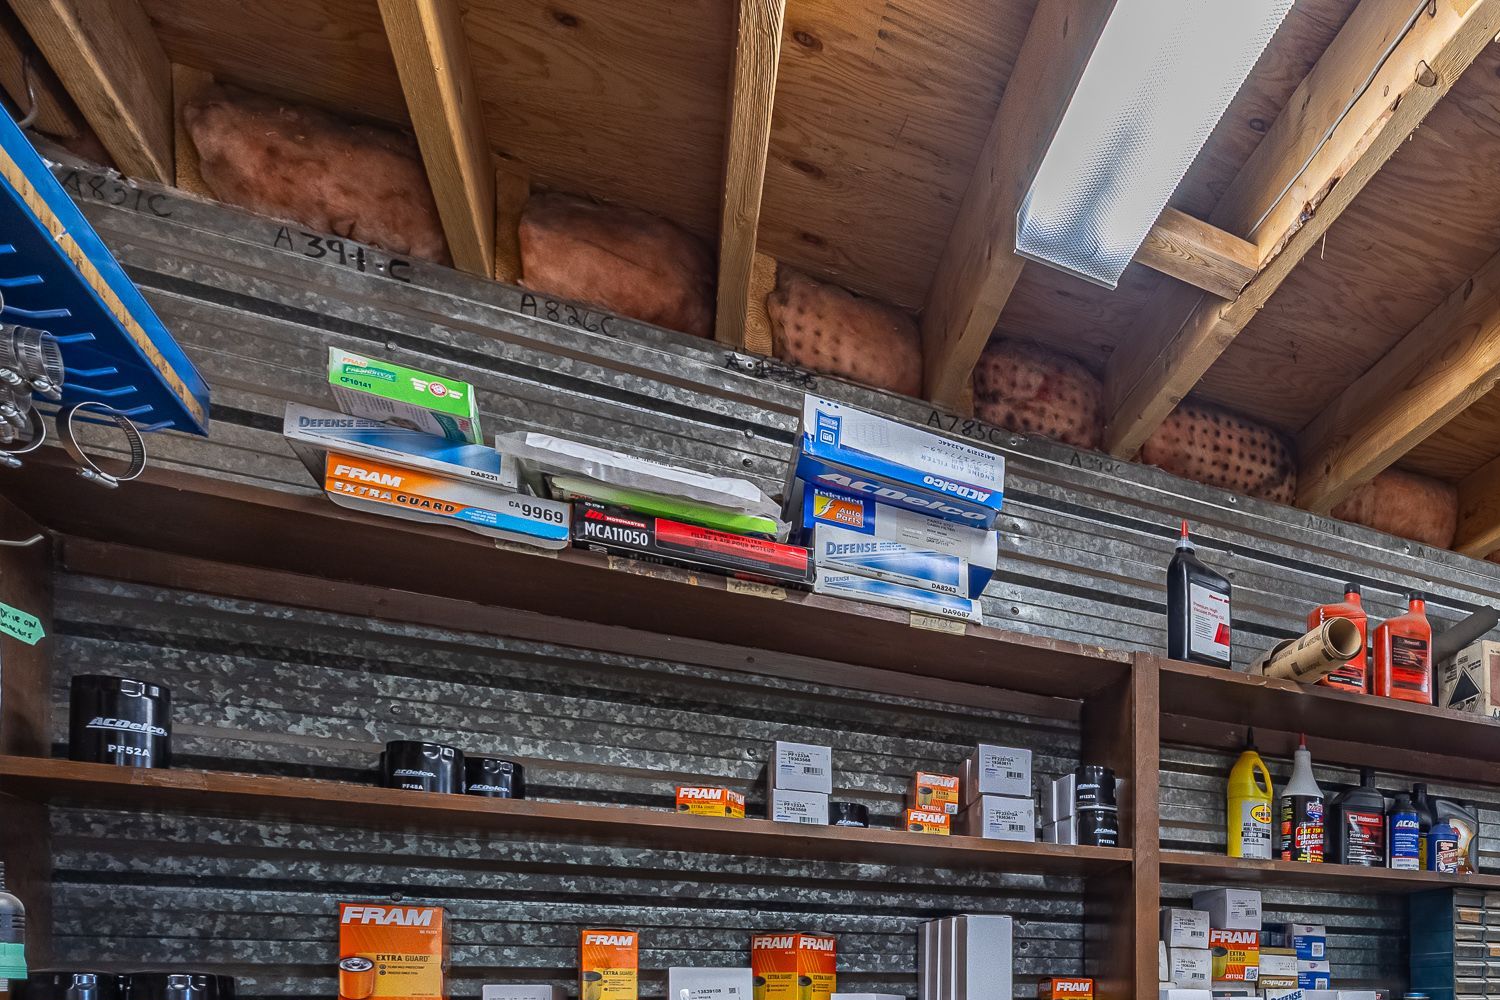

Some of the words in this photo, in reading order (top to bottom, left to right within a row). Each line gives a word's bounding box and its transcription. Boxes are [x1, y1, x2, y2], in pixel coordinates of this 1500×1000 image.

[299, 416, 354, 428] DEFENSE
[334, 464, 401, 487] FRAM
[923, 474, 991, 503] ACDelco
[334, 482, 392, 500] EXTRA
[397, 495, 455, 513] GUARD
[816, 473, 988, 521] ACDelco
[509, 501, 520, 509] CA
[522, 504, 564, 524] 9969
[836, 512, 862, 525] Parts
[839, 507, 861, 518] Auto
[606, 516, 646, 528] MOTOMASTER
[584, 521, 648, 546] MCA11050
[826, 542, 878, 555] DEFENSE
[824, 575, 850, 583] DEFENSE
[931, 583, 957, 594] DA8243
[942, 608, 970, 618] DA9687
[87, 717, 168, 736] ACDelco
[107, 744, 150, 757] PF52A
[919, 775, 954, 787] FRAM
[679, 787, 722, 799] FRAM
[910, 811, 945, 824] FRAM
[341, 906, 434, 926] FRAM
[585, 934, 633, 946] FRAM
[753, 937, 793, 950] FRAM
[799, 937, 834, 951] FRAM
[1211, 930, 1257, 945] FRAM
[1056, 982, 1090, 992] FRAM
[1261, 979, 1294, 988] ACDelco
